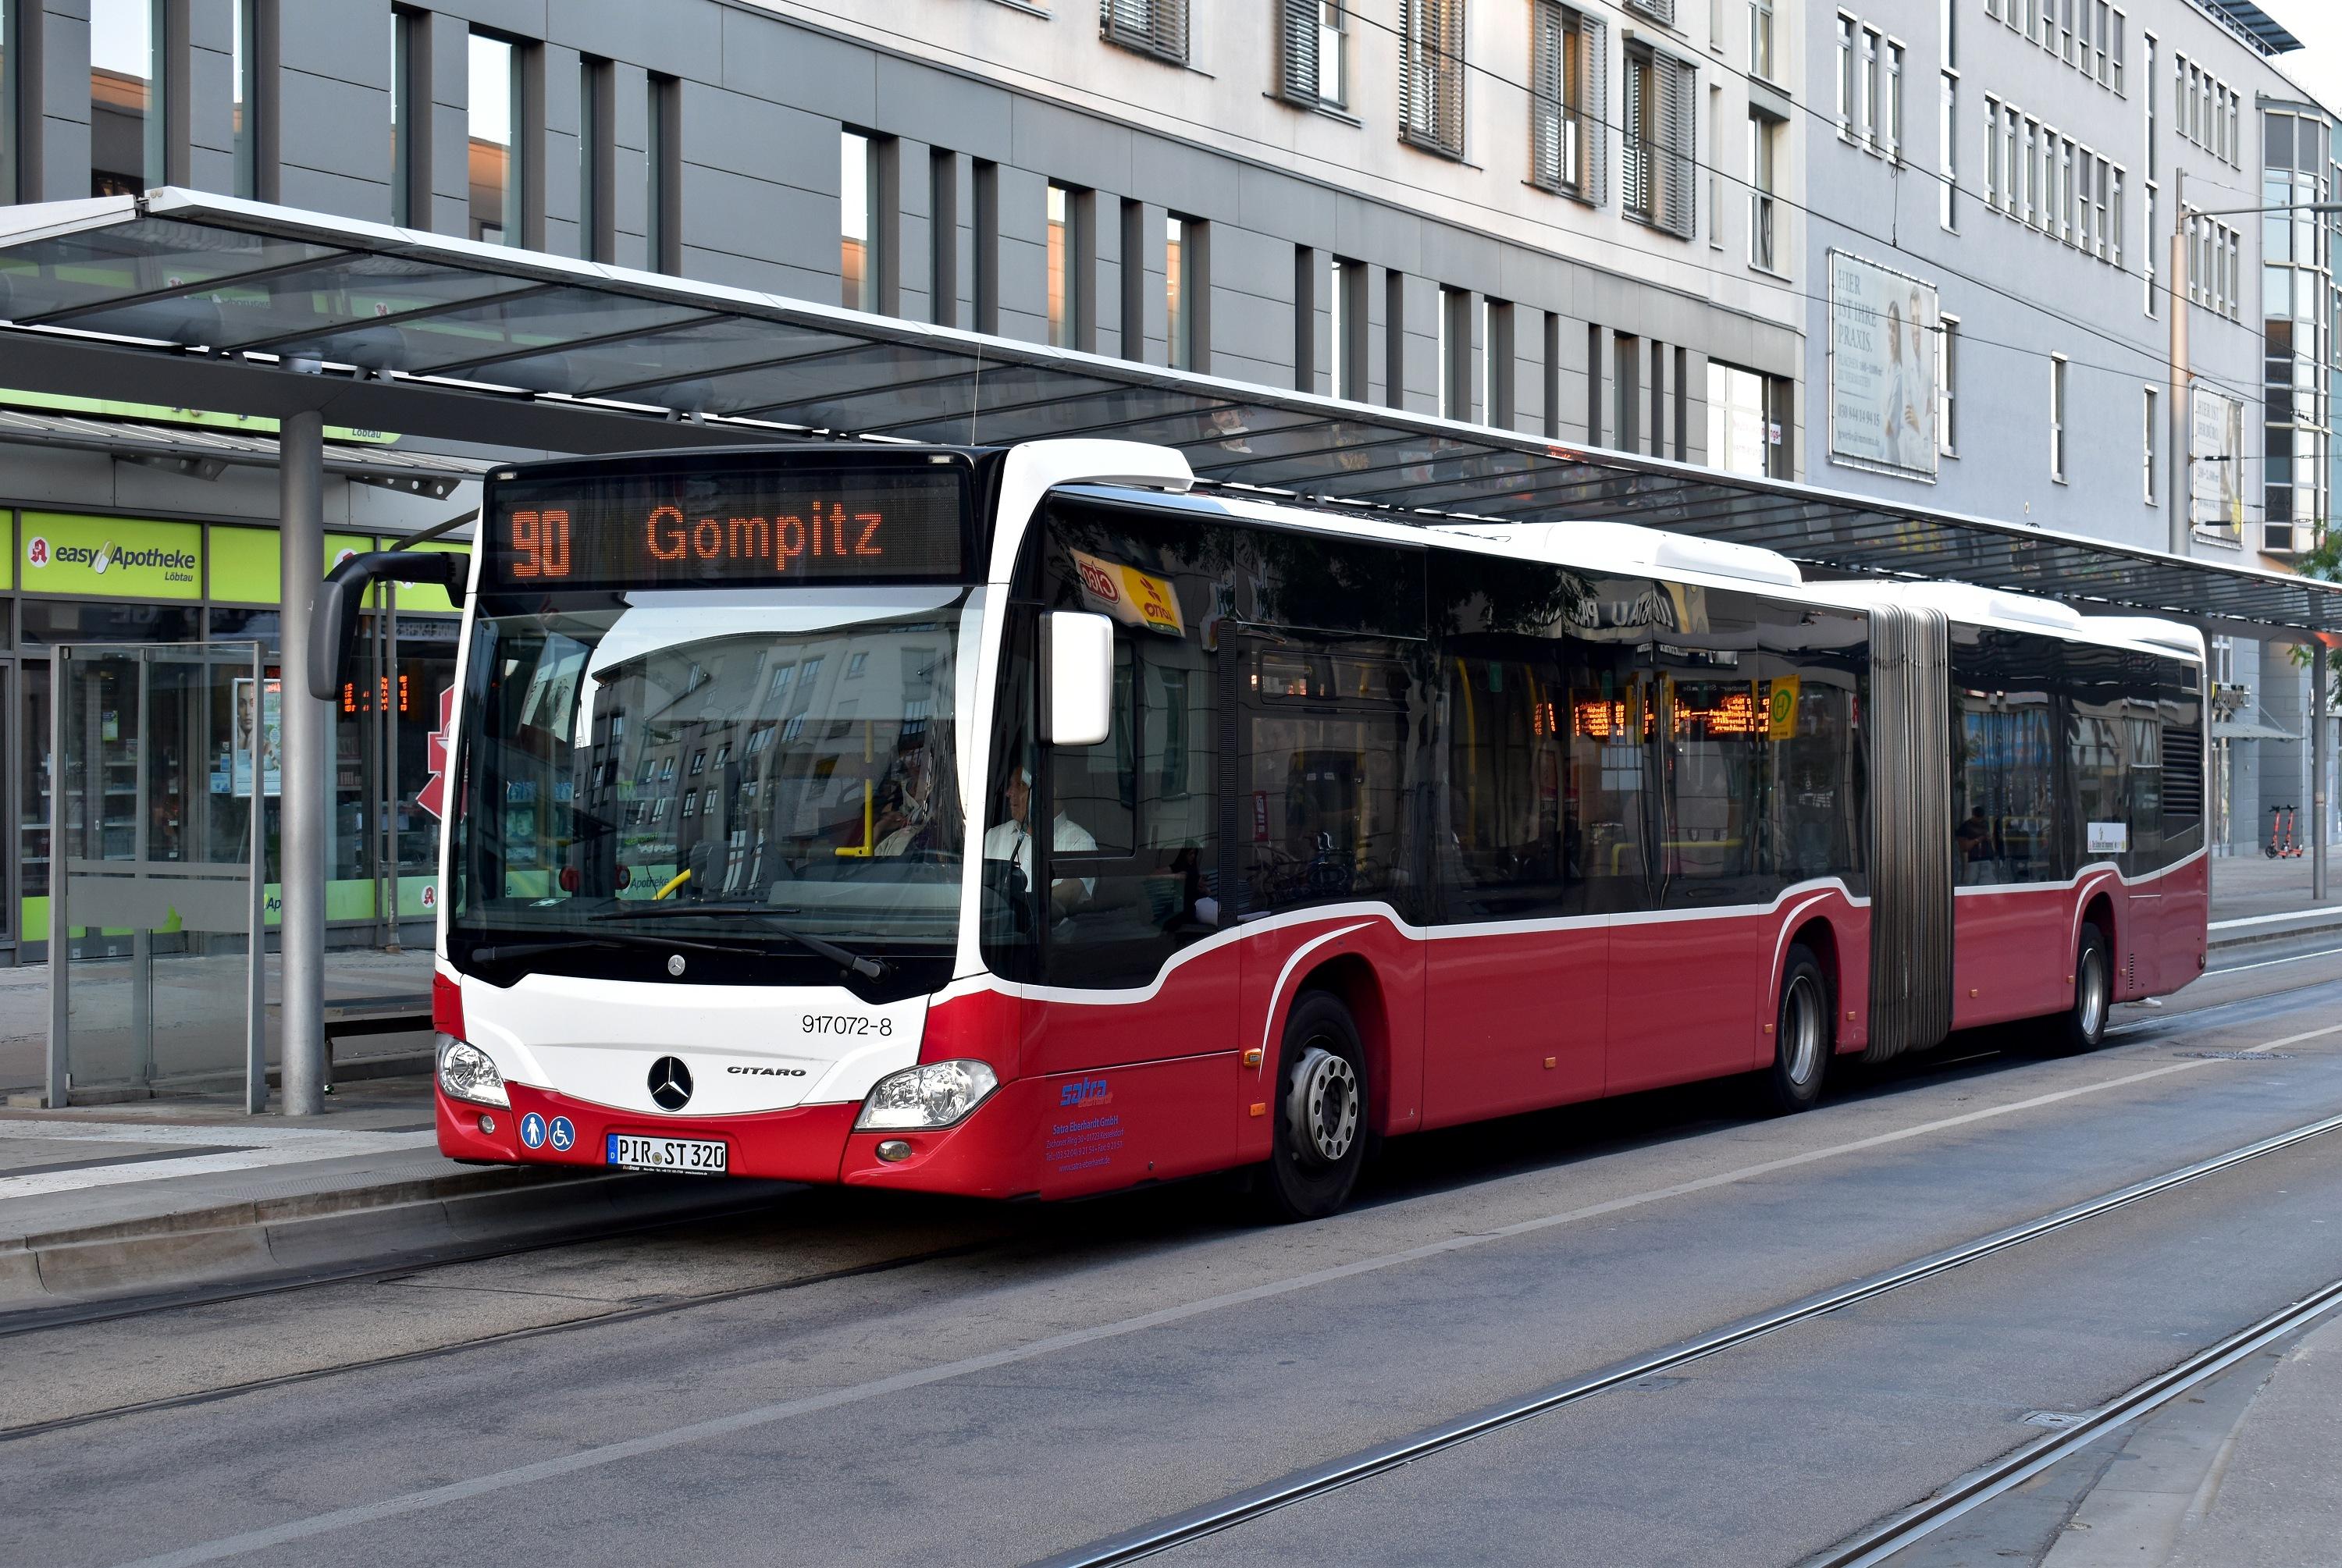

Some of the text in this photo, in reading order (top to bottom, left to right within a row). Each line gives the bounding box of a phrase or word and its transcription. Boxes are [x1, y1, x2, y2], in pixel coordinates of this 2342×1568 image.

[1838, 270, 1860, 296] HIER
[1838, 297, 1877, 328] IST IHRE
[512, 501, 882, 577] 90 Gompitz
[165, 571, 193, 582] Löbtau
[803, 1015, 892, 1036] 917072-8
[727, 1066, 806, 1076] CITARO
[1060, 1077, 1107, 1106] satra
[1052, 1115, 1119, 1135] Satra Eberhardt GmbH
[619, 1139, 651, 1163] PIR
[664, 1143, 687, 1166] ST
[691, 1144, 724, 1168] 320
